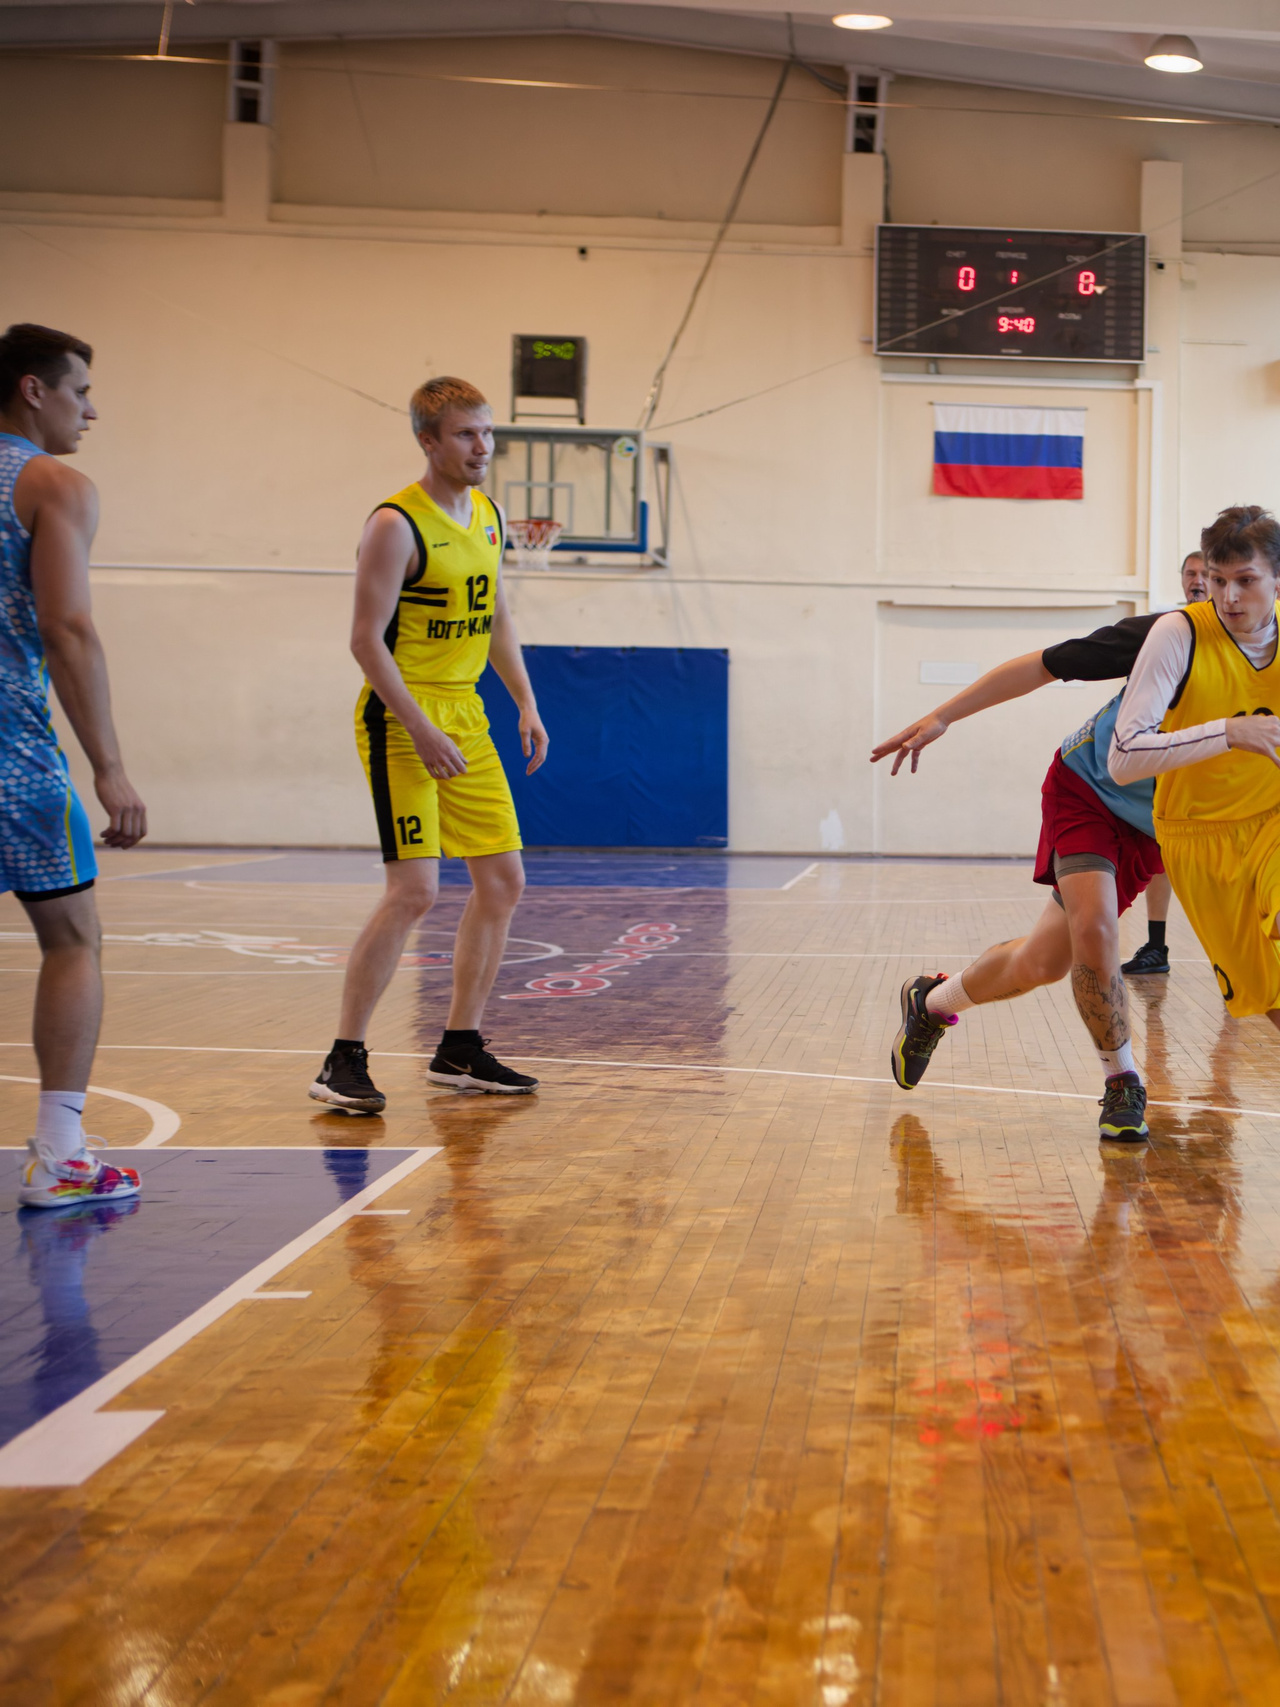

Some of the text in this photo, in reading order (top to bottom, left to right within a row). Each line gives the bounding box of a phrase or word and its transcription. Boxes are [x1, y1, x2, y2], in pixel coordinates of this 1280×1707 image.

[958, 266, 976, 291] 0
[1010, 270, 1018, 284] 1
[998, 316, 1035, 333] 9:40
[465, 574, 489, 612] 12
[396, 815, 423, 845] 12
